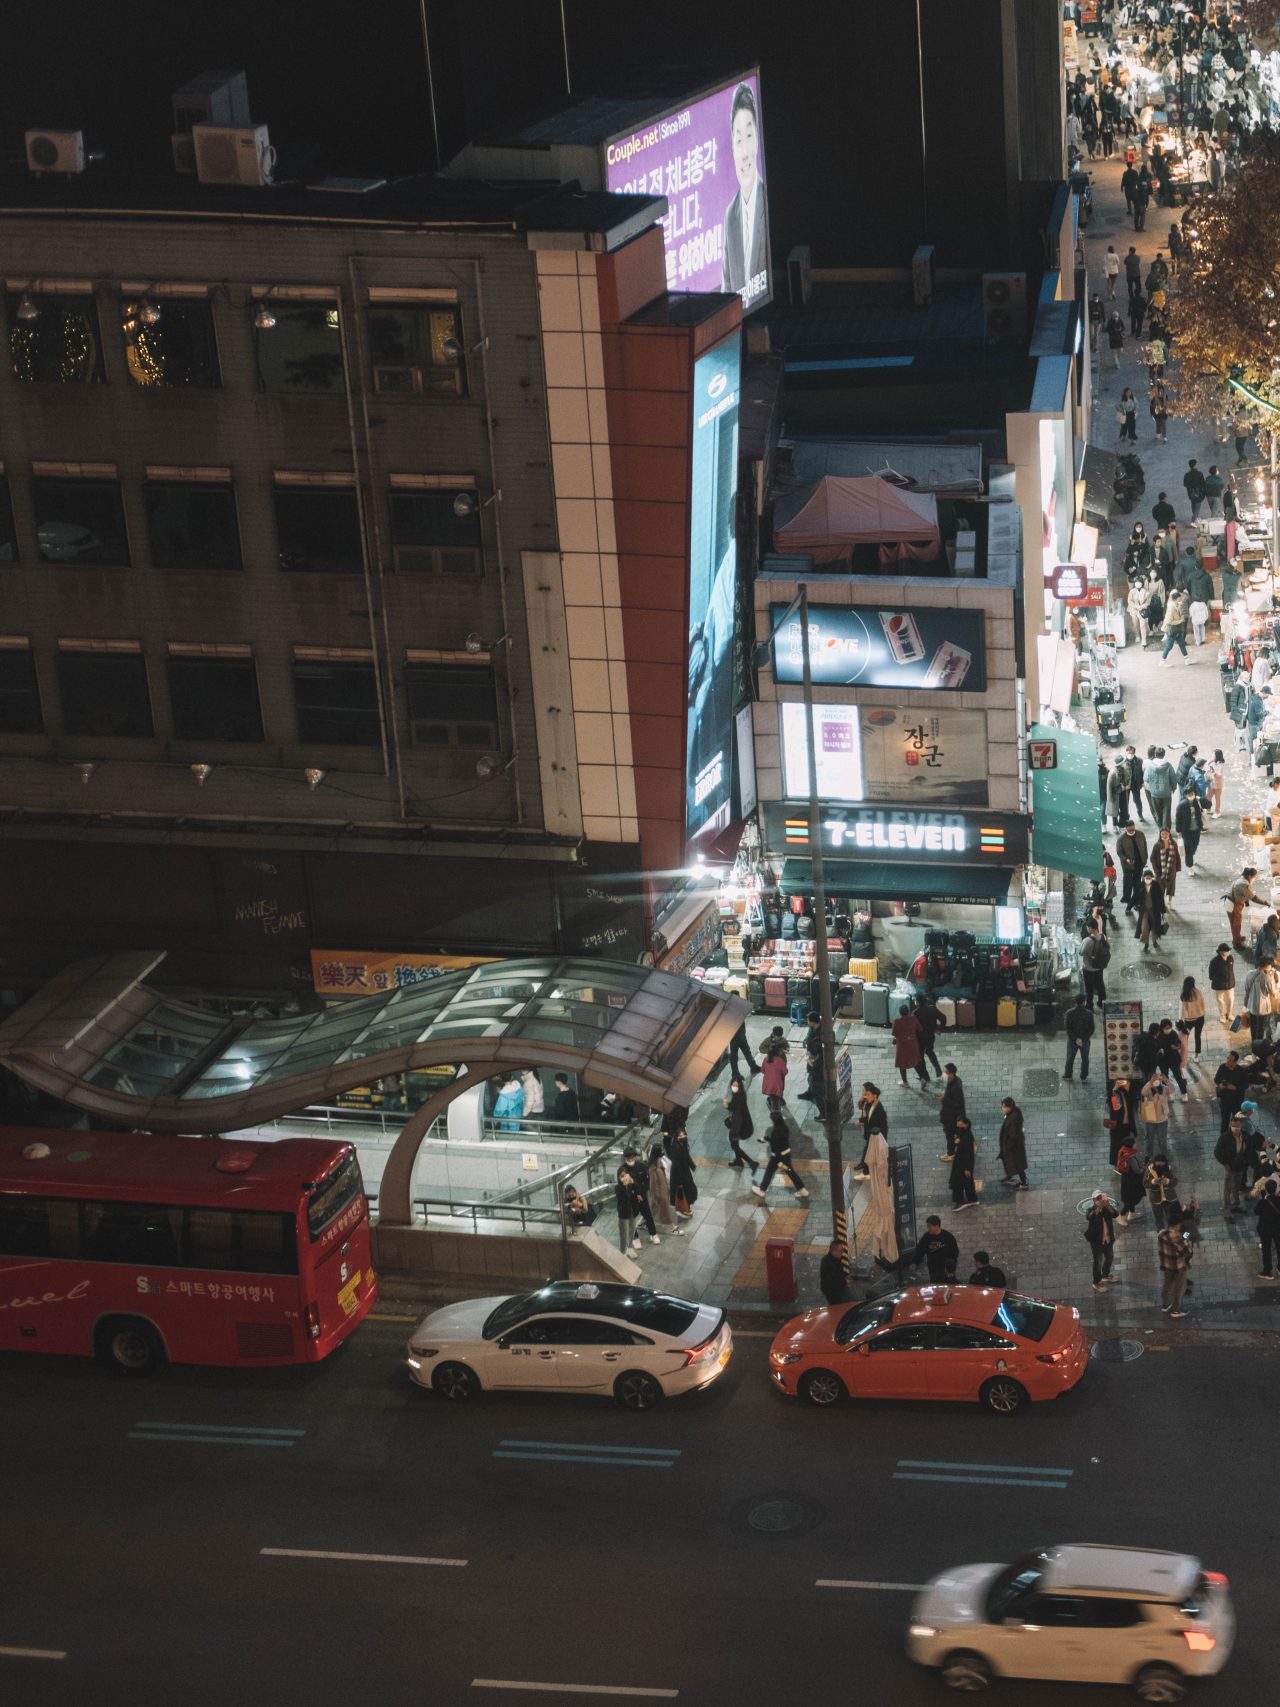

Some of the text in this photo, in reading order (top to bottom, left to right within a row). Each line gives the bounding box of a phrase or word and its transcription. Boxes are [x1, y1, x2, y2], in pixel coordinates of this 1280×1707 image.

[607, 129, 659, 166] Couple.net
[320, 962, 369, 988] 樂天
[166, 1279, 275, 1303] 스마트항공여행사
